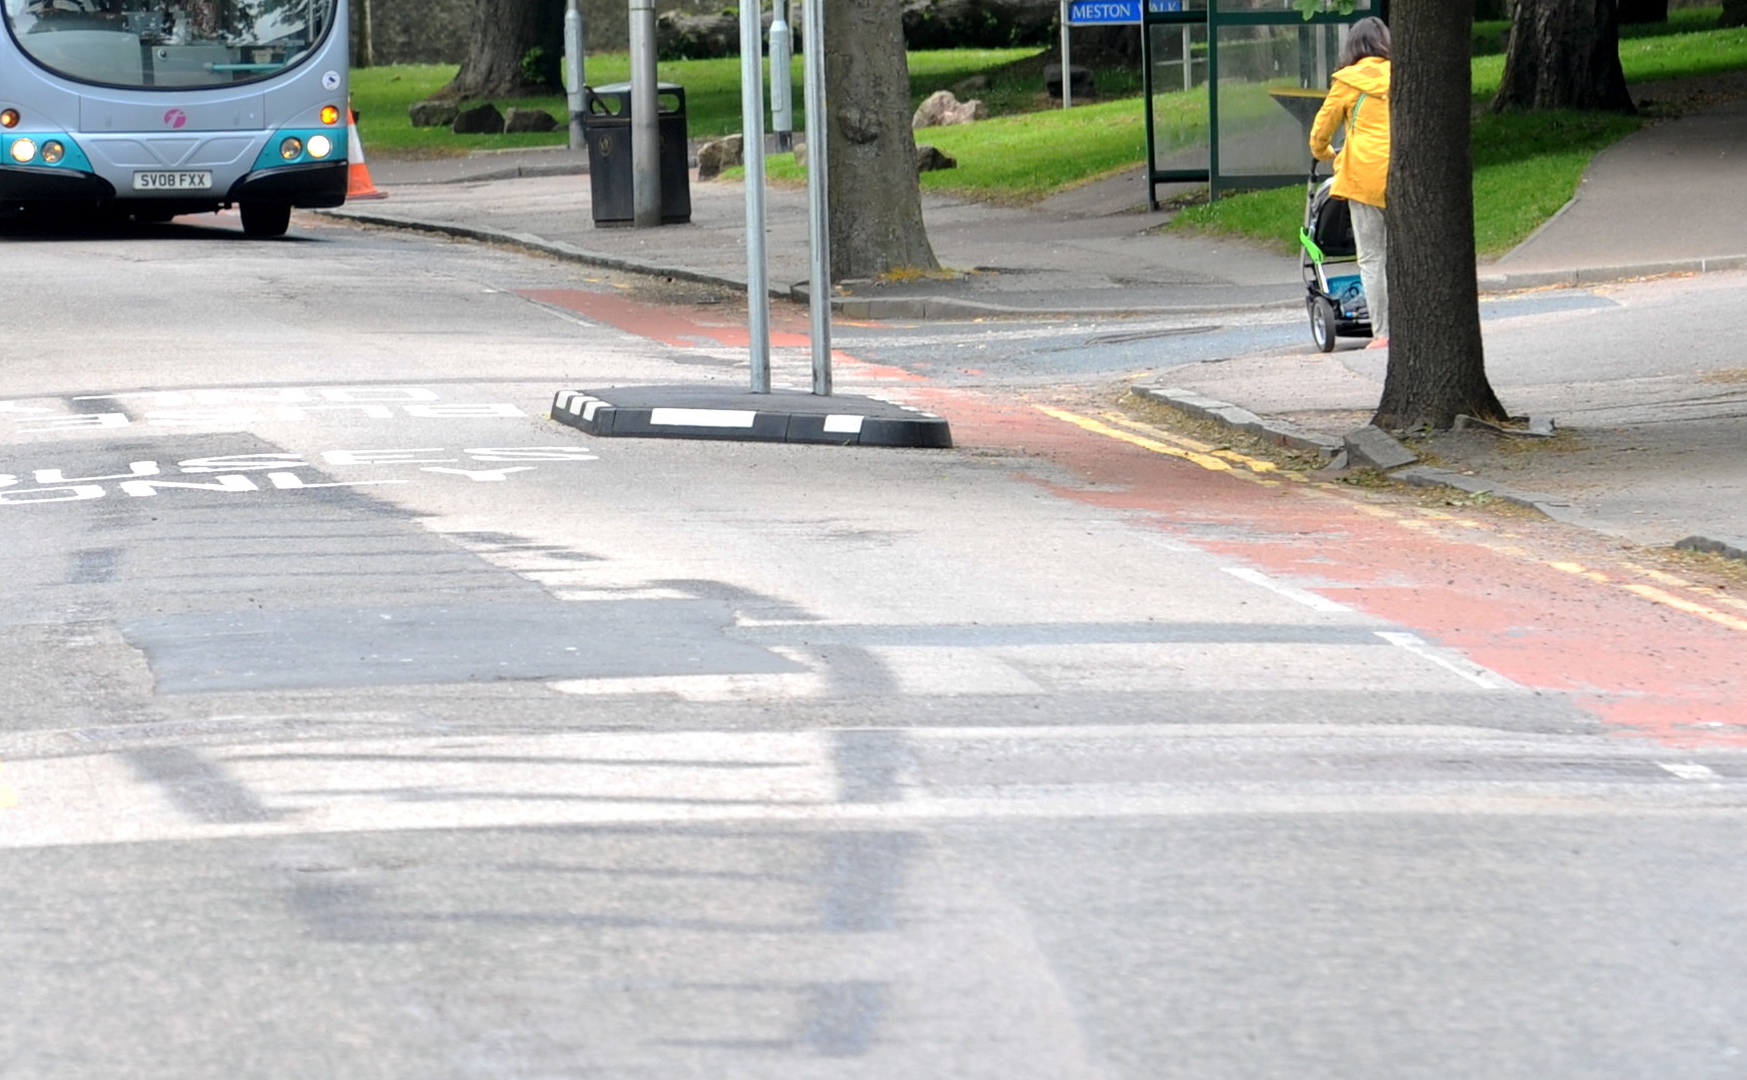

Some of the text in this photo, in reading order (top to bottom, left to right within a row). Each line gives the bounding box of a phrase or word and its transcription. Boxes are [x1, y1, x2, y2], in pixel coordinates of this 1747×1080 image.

[1073, 3, 1131, 19] MESTON
[141, 173, 206, 187] SV08 FXX
